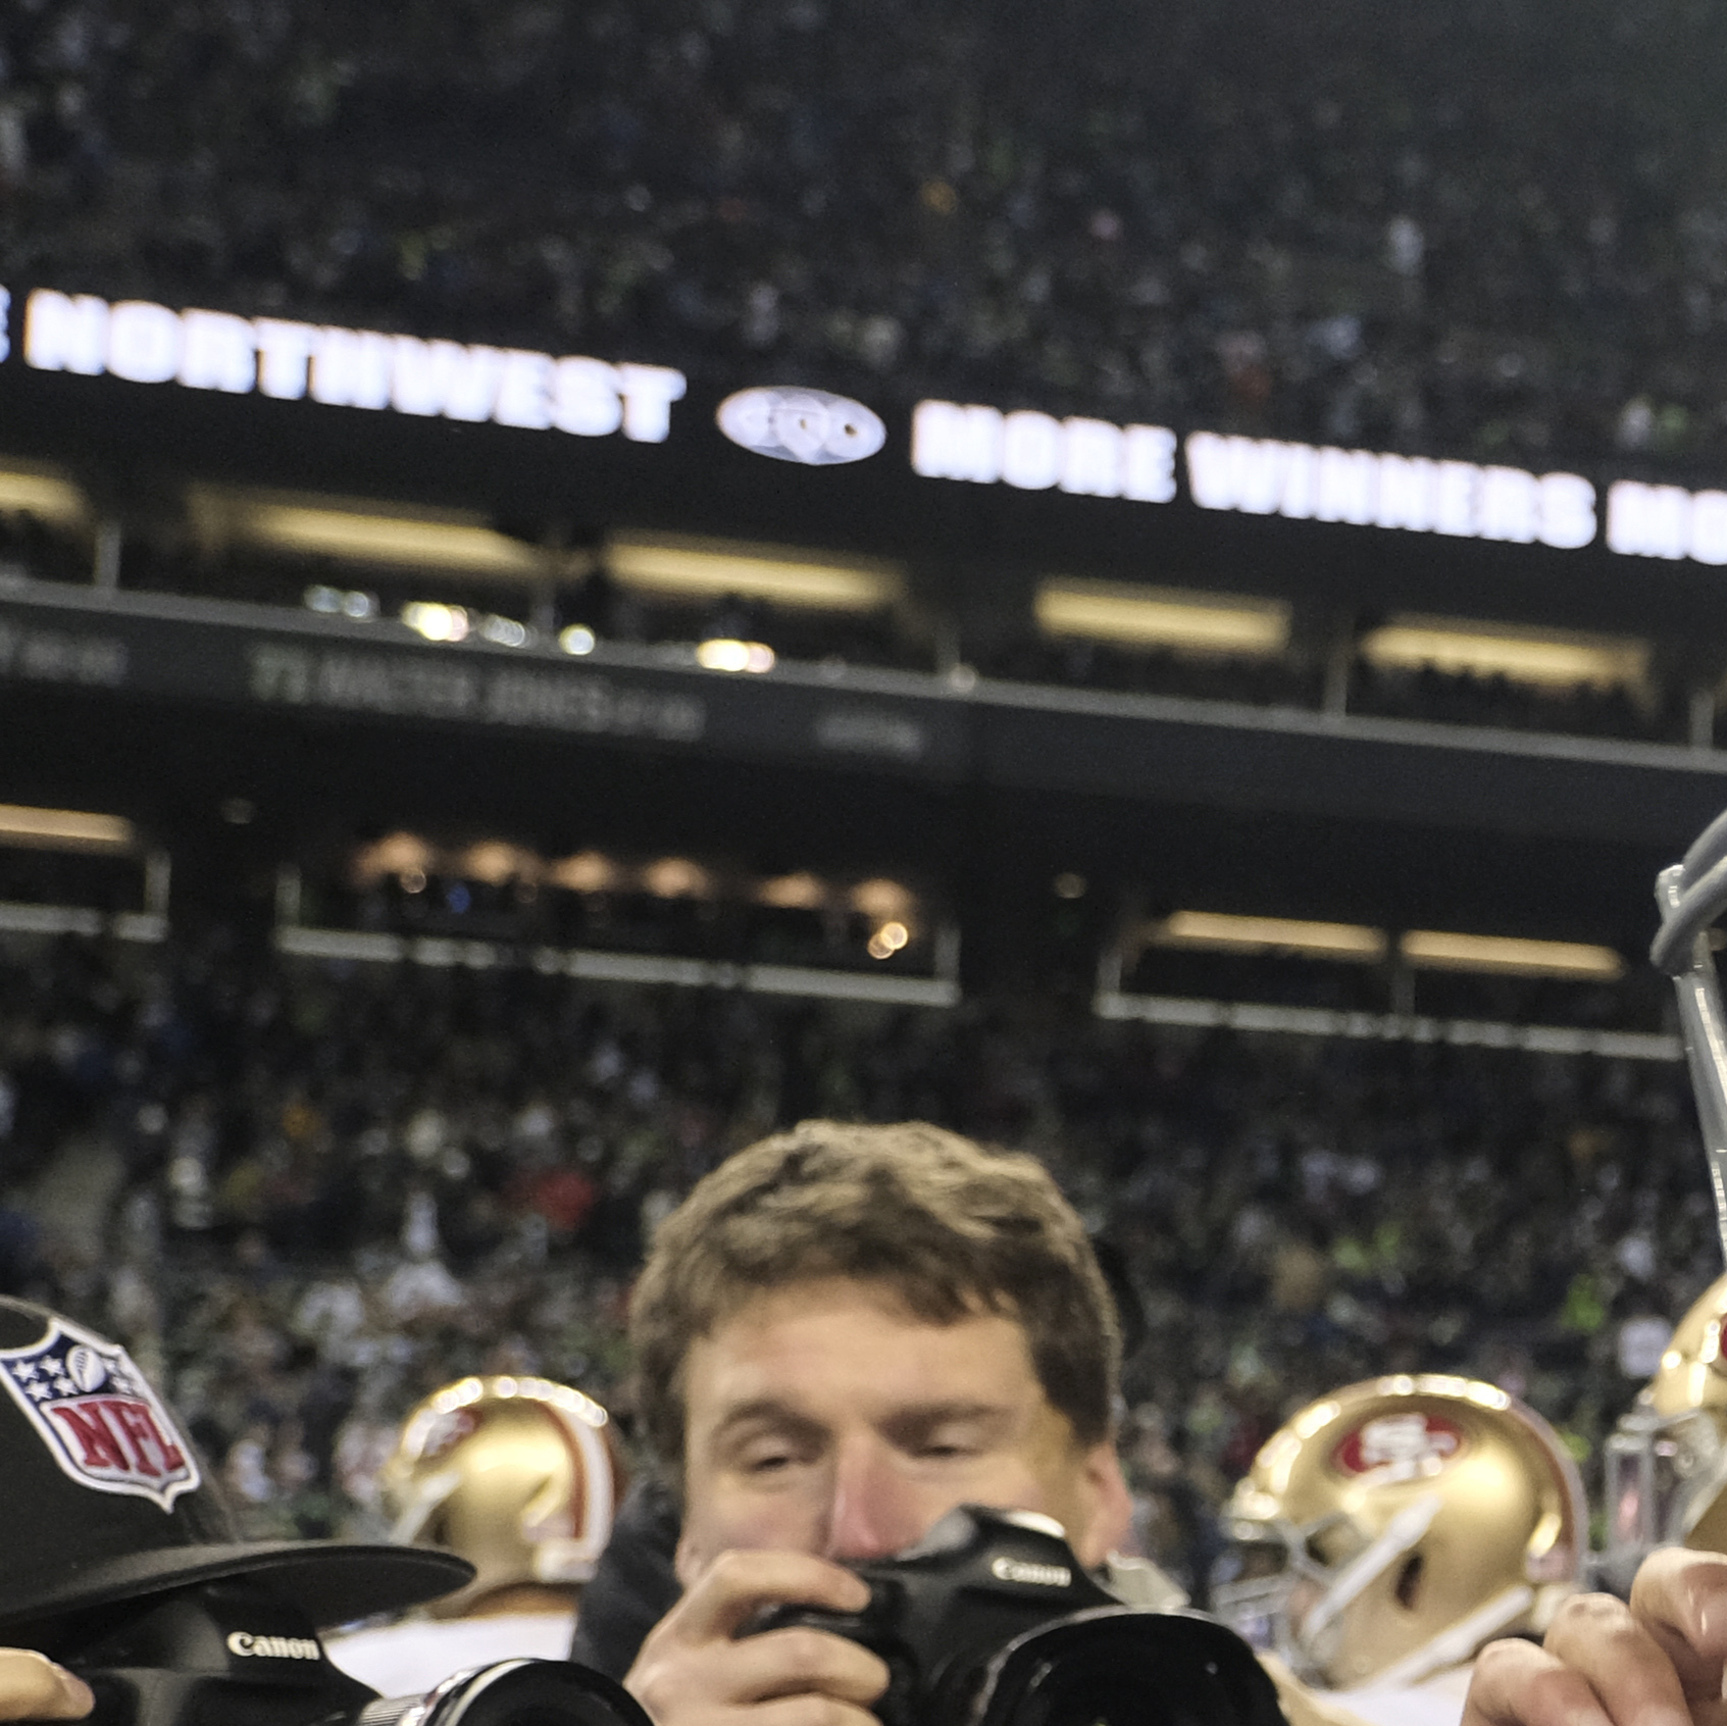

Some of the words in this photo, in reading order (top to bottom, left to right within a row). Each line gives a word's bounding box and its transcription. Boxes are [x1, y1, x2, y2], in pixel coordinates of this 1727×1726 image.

[25, 289, 687, 443] NORTHWEST
[912, 399, 1177, 503] MORE
[1186, 431, 1596, 549] WINNERS
[50, 1399, 186, 1477] NFL
[227, 1631, 320, 1660] Canon
